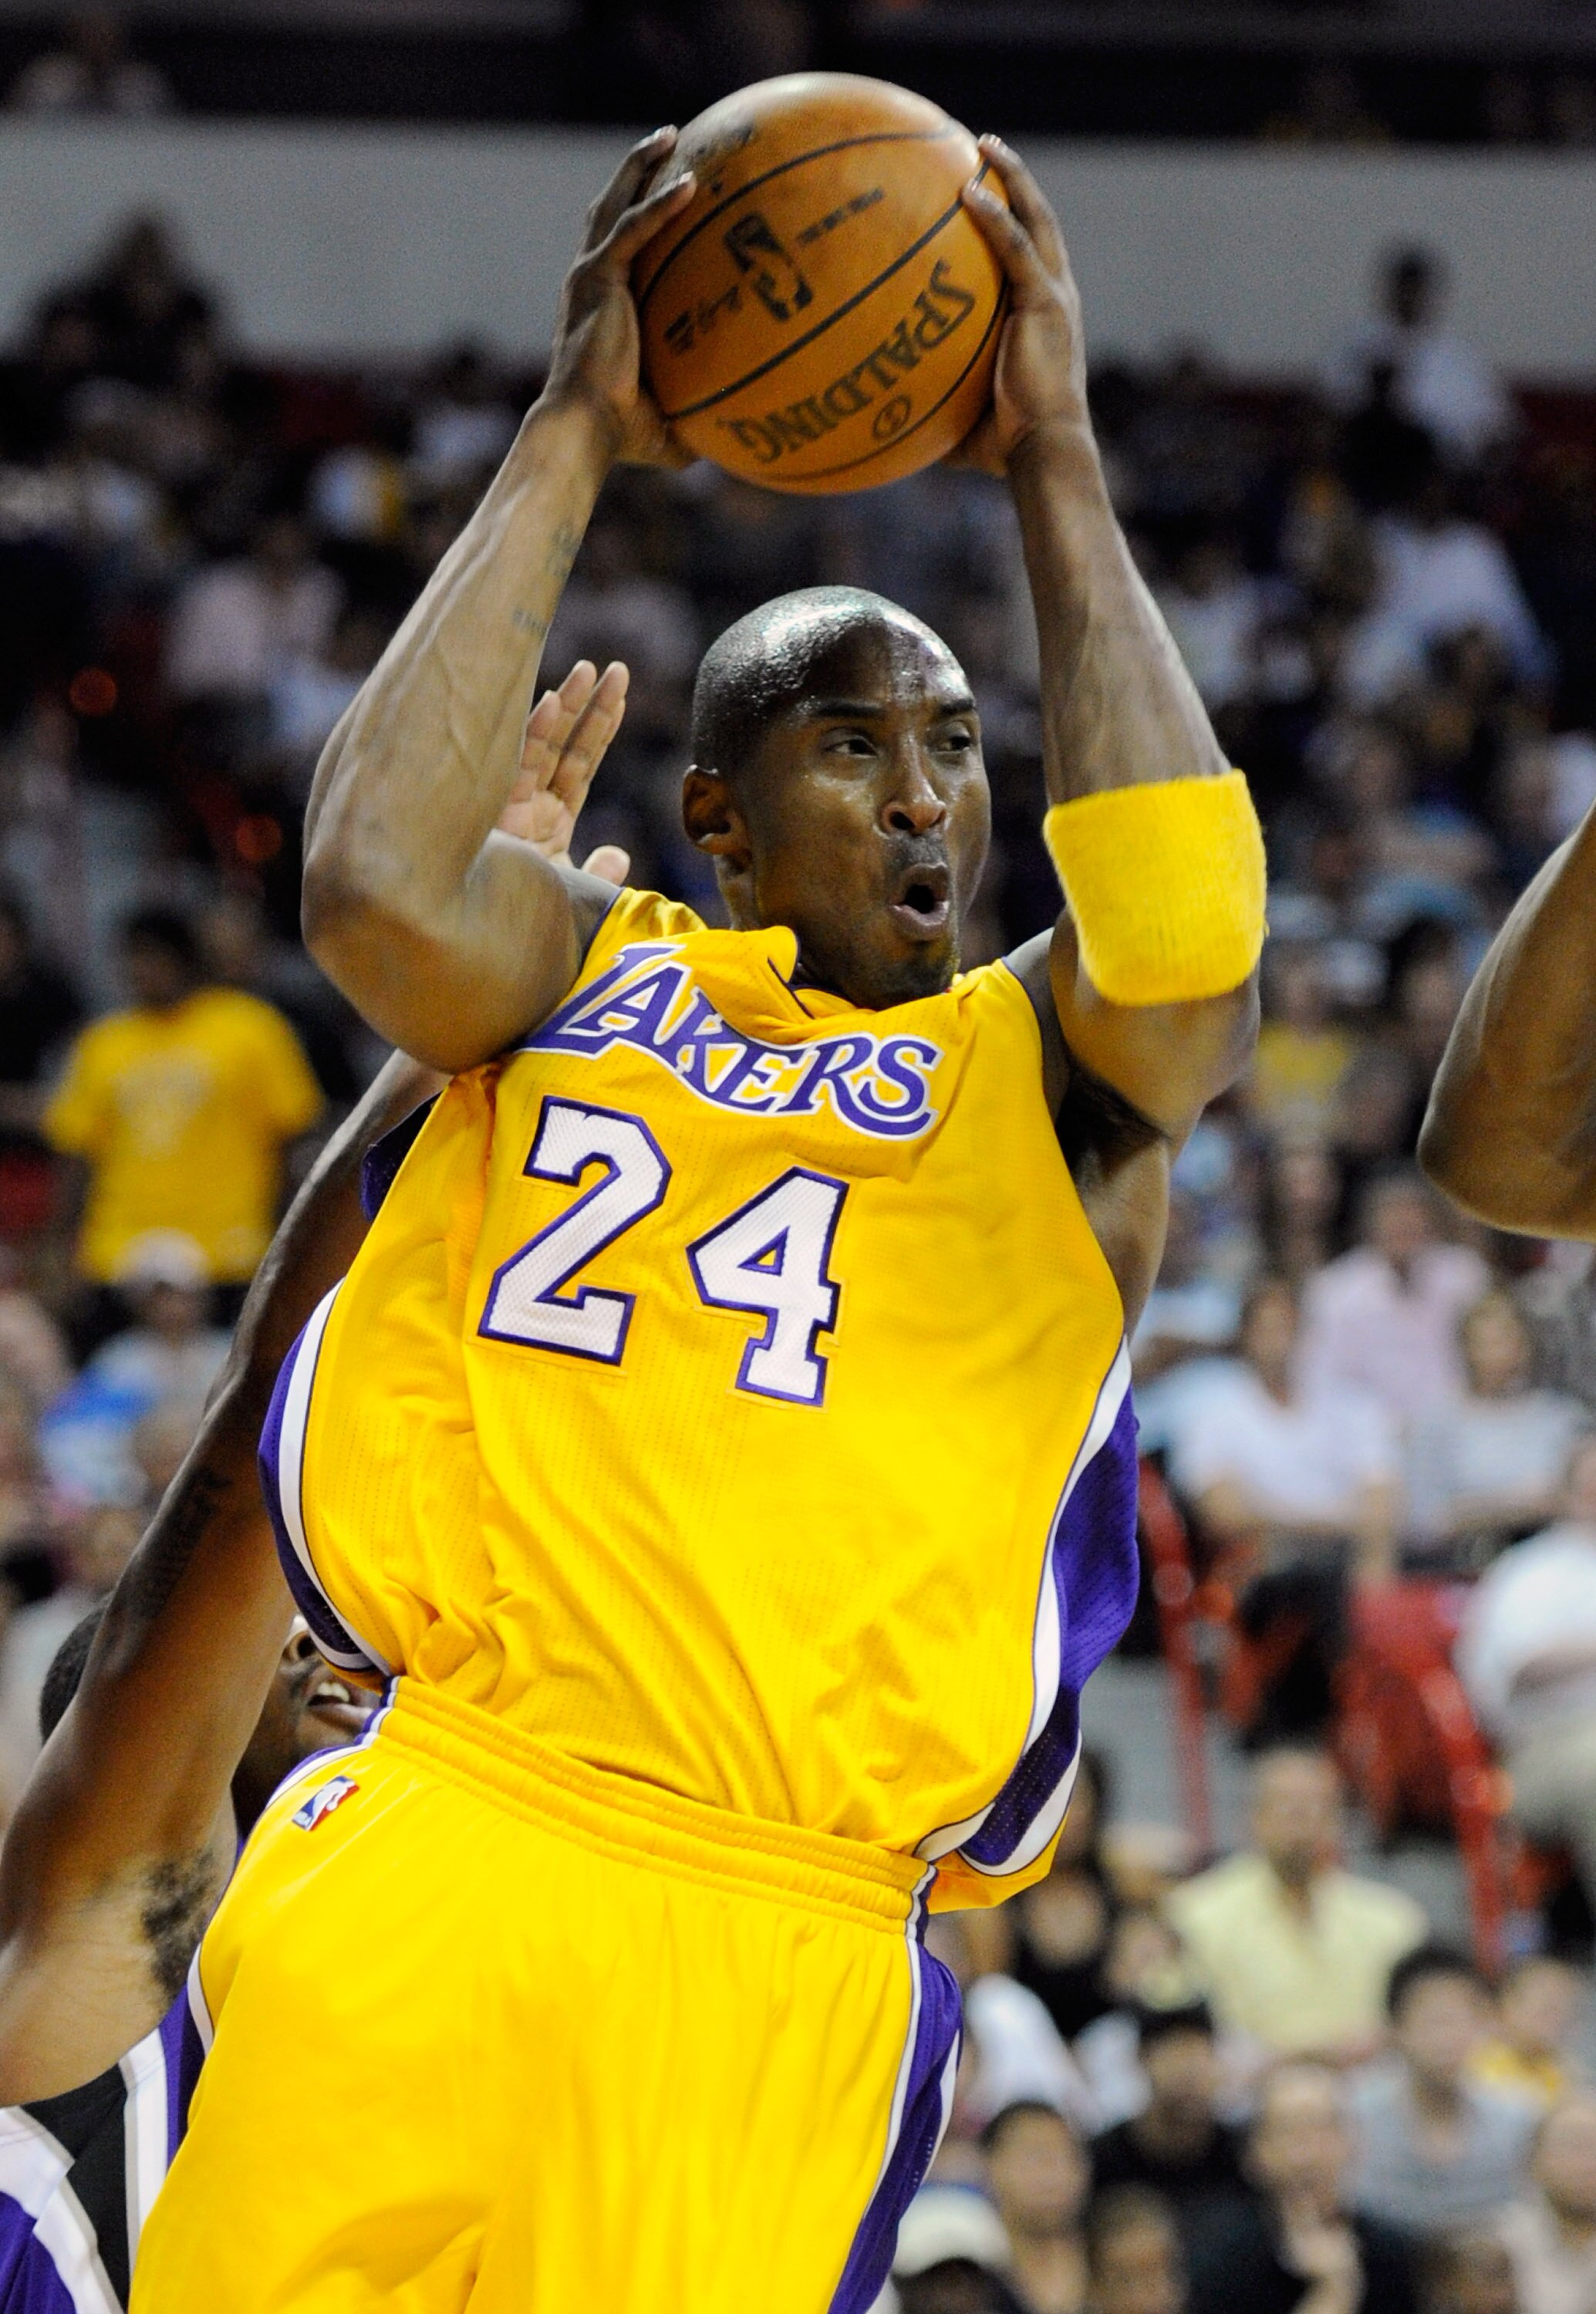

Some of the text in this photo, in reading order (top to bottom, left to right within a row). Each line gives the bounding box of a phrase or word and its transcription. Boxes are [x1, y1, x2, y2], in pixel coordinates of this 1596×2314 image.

[716, 258, 975, 463] SPALDING
[514, 942, 944, 1141] LAKERS
[477, 1095, 849, 1408] 24
